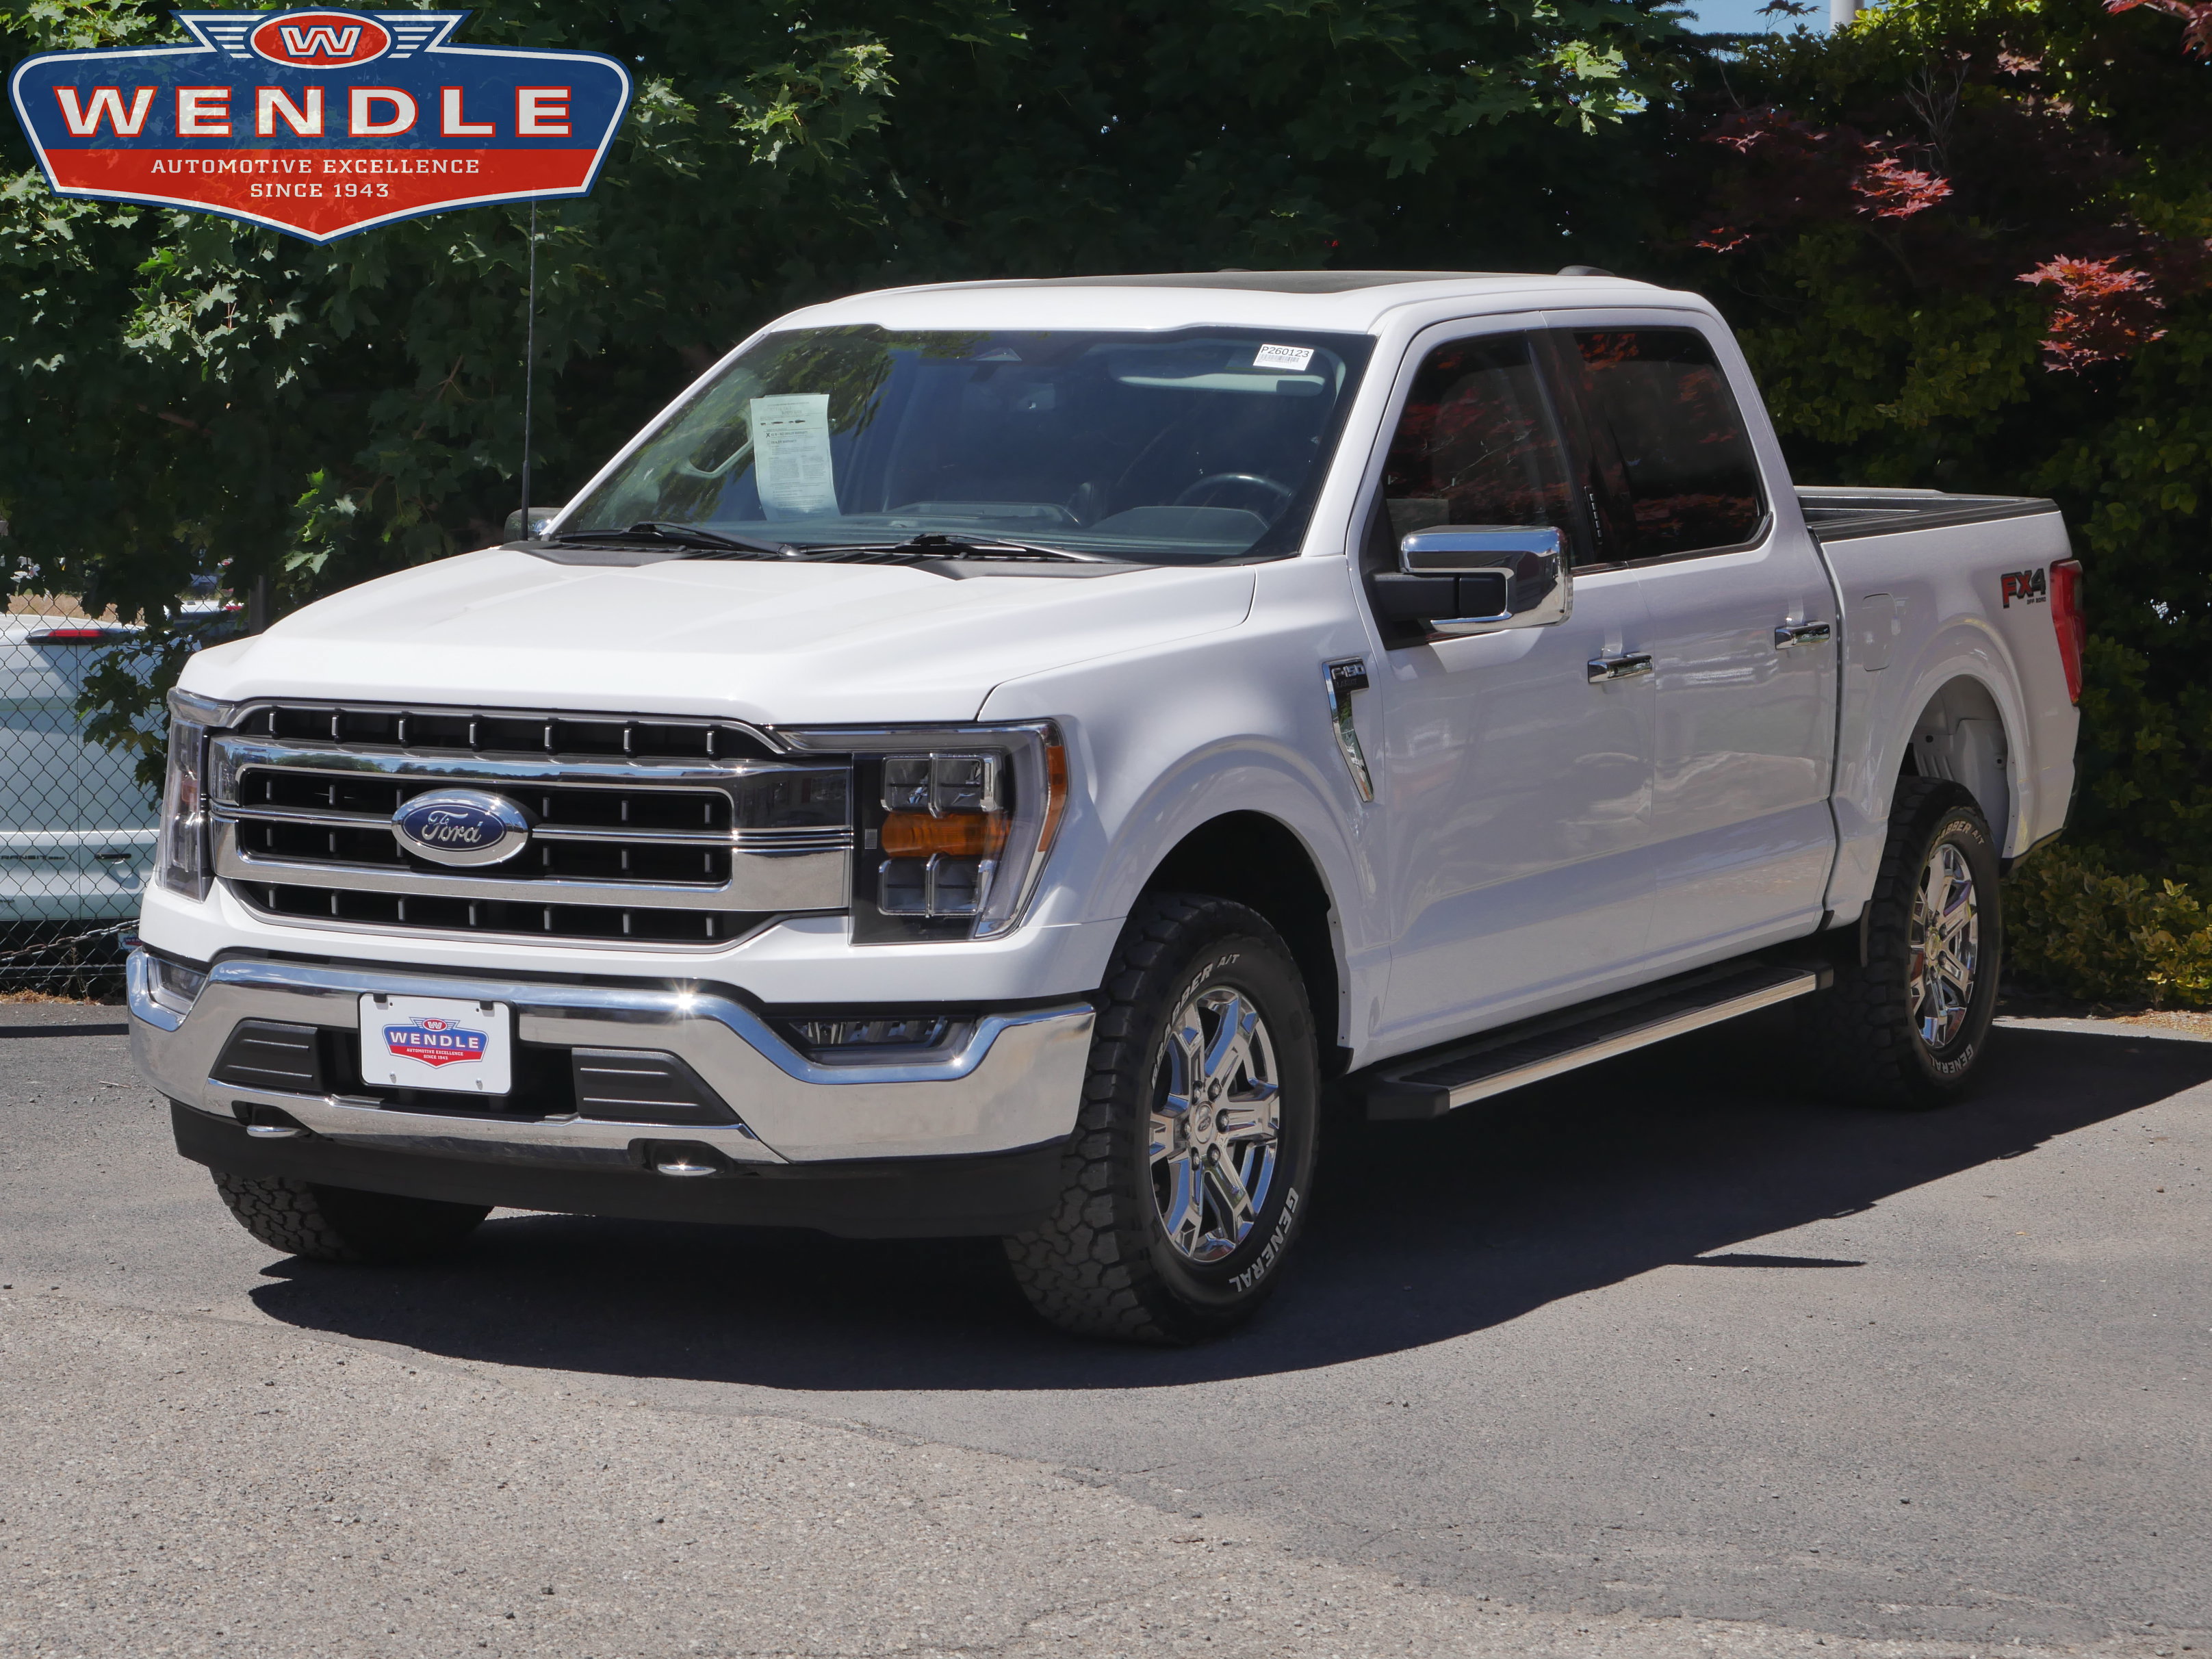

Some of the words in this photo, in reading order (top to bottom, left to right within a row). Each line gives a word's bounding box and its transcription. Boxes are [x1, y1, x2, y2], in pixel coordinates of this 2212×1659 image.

[1261, 346, 1309, 358] P260123
[2001, 568, 2046, 609] FX4
[1331, 664, 1365, 680] F-150
[422, 810, 483, 843] Ford
[1972, 830, 1984, 845] A/T
[1217, 954, 1240, 968] A/T
[390, 1031, 478, 1049] WENDLE
[1929, 1044, 1974, 1074] GENERAL
[1229, 1187, 1299, 1292] GENERAL
